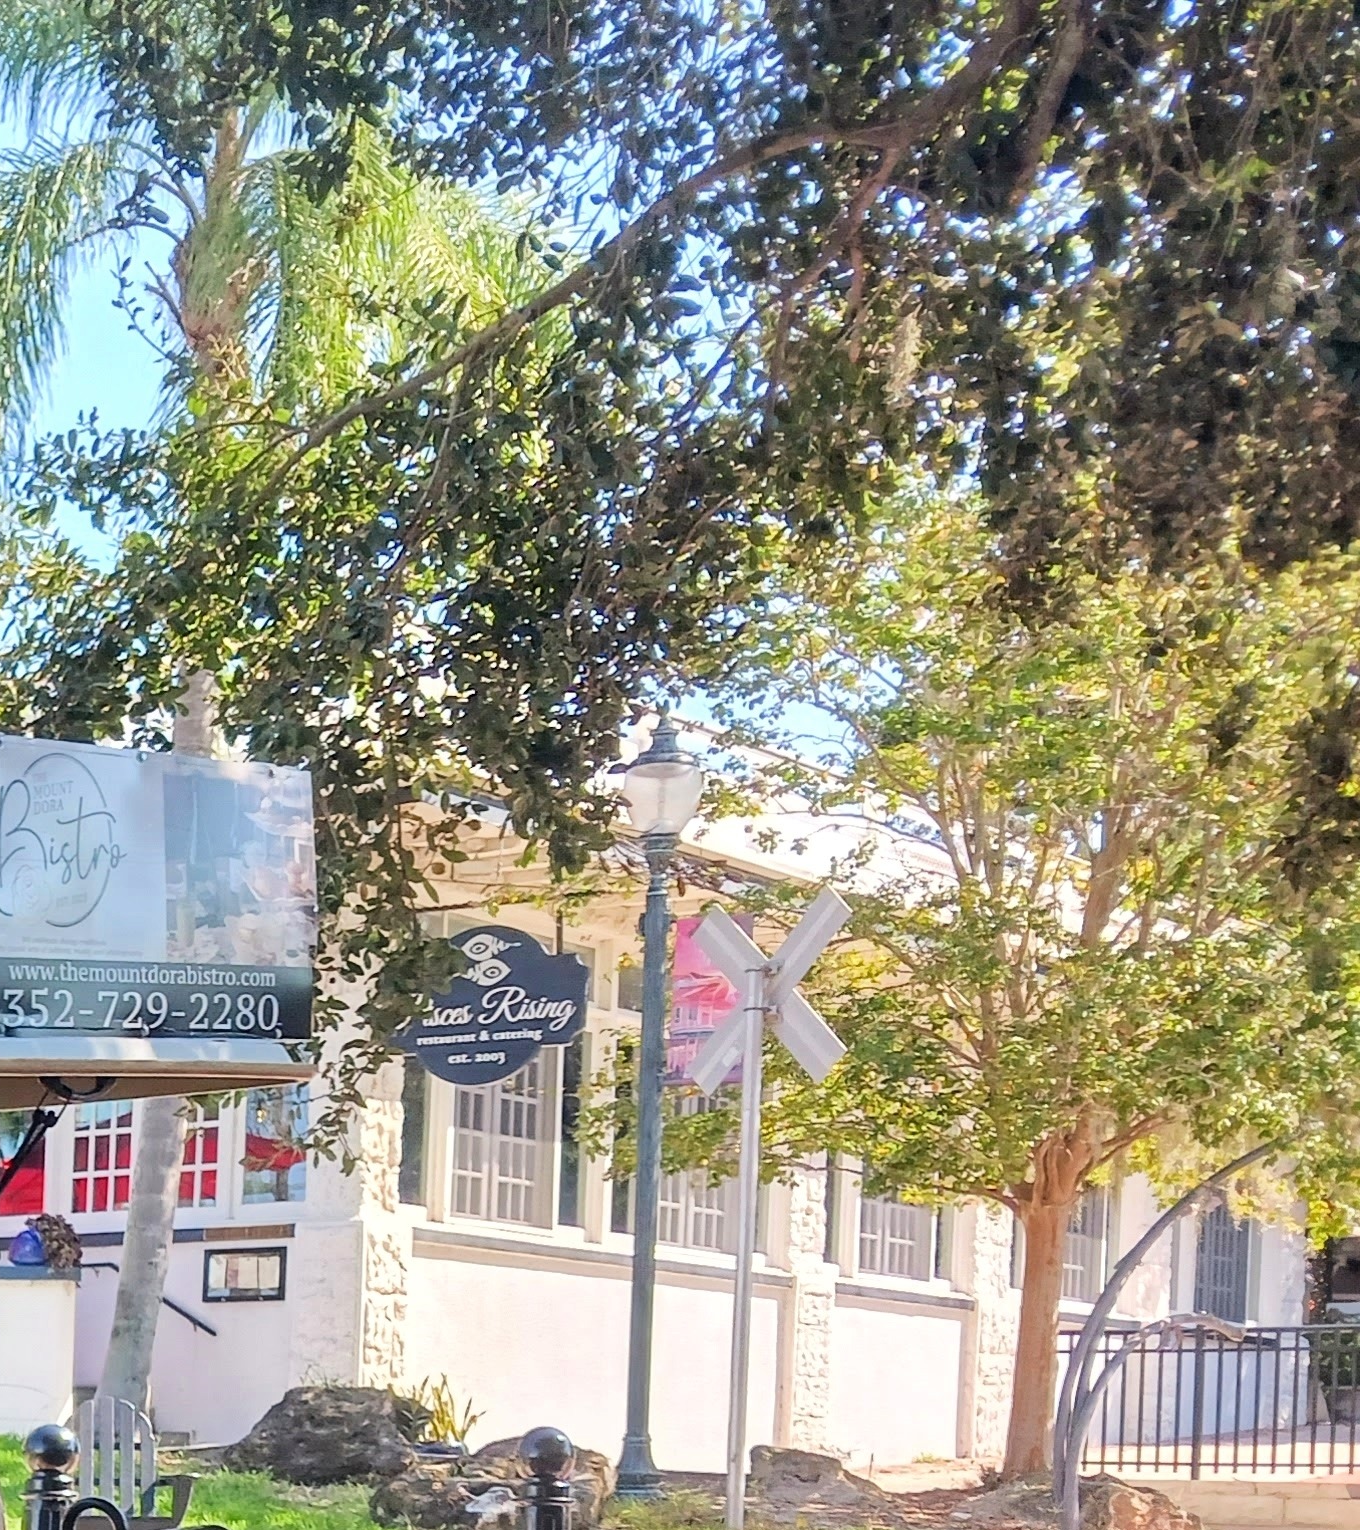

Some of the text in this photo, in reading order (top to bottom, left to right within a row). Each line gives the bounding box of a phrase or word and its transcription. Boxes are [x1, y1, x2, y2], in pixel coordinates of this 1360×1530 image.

[32, 780, 74, 800] MOUNT
[33, 798, 64, 815] DORA
[8, 962, 277, 987] www.themountdorabistro.com
[2, 987, 280, 1032] 352-729-2280
[478, 986, 576, 1031] Rising
[416, 1028, 543, 1046] restaurant & catering
[448, 1053, 472, 1065] est.
